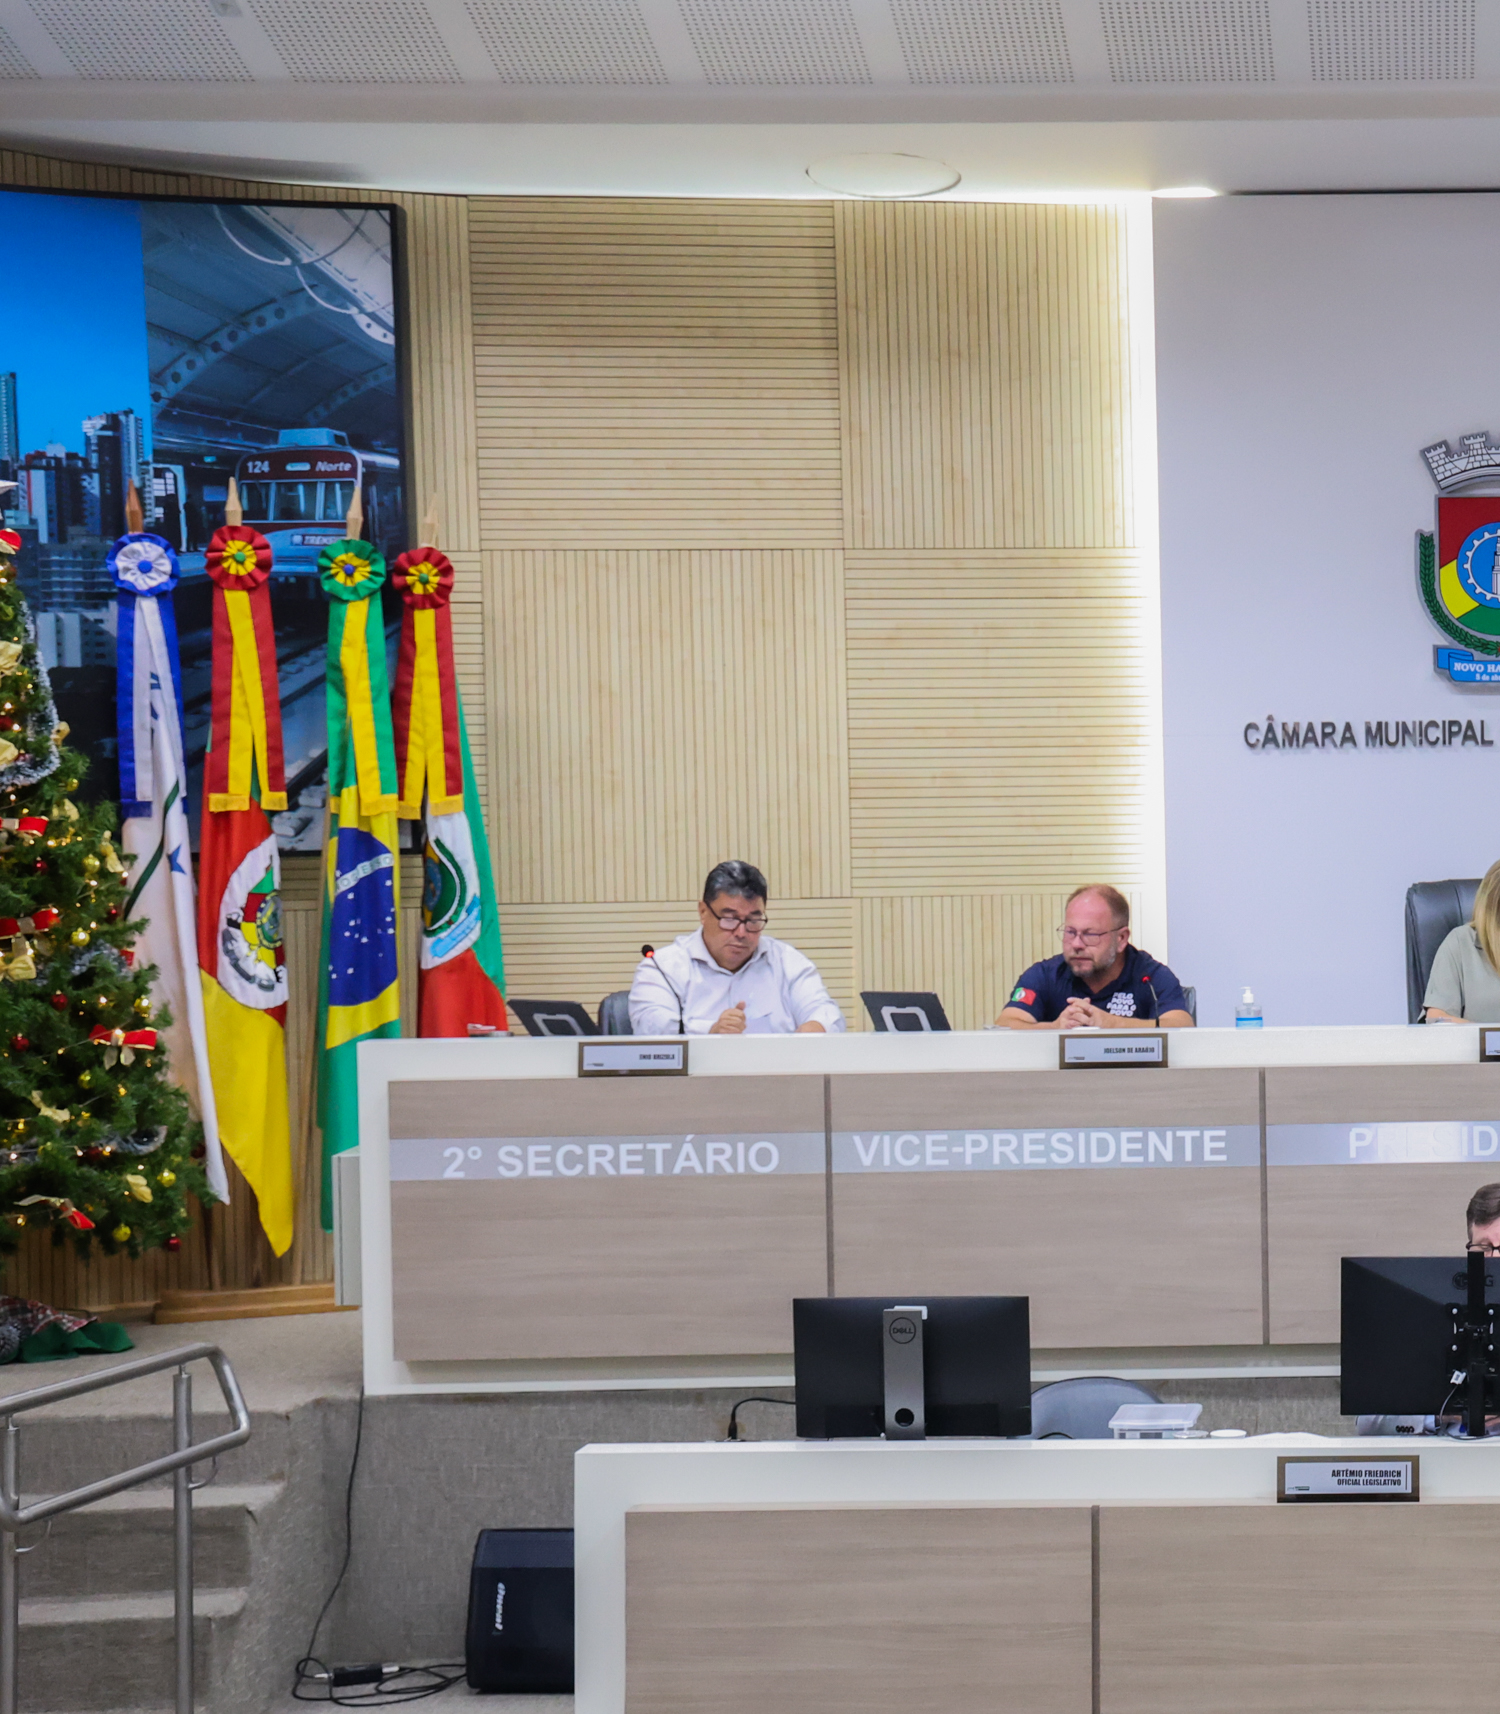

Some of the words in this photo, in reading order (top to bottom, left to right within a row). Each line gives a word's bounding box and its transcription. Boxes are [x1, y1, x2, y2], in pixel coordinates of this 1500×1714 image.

[246, 461, 270, 473] 124
[315, 461, 352, 472] Norte
[1454, 662, 1484, 672] NOVO
[1244, 714, 1358, 750] CÂMARA
[1365, 719, 1494, 747] MUNICIPAL
[852, 1130, 1228, 1167] VICE-PRESIDENTE
[497, 1134, 780, 1177] SECRETÁRIO
[1364, 1470, 1401, 1478] FRIEDRICH
[1362, 1478, 1401, 1486] LEGISLATIVO
